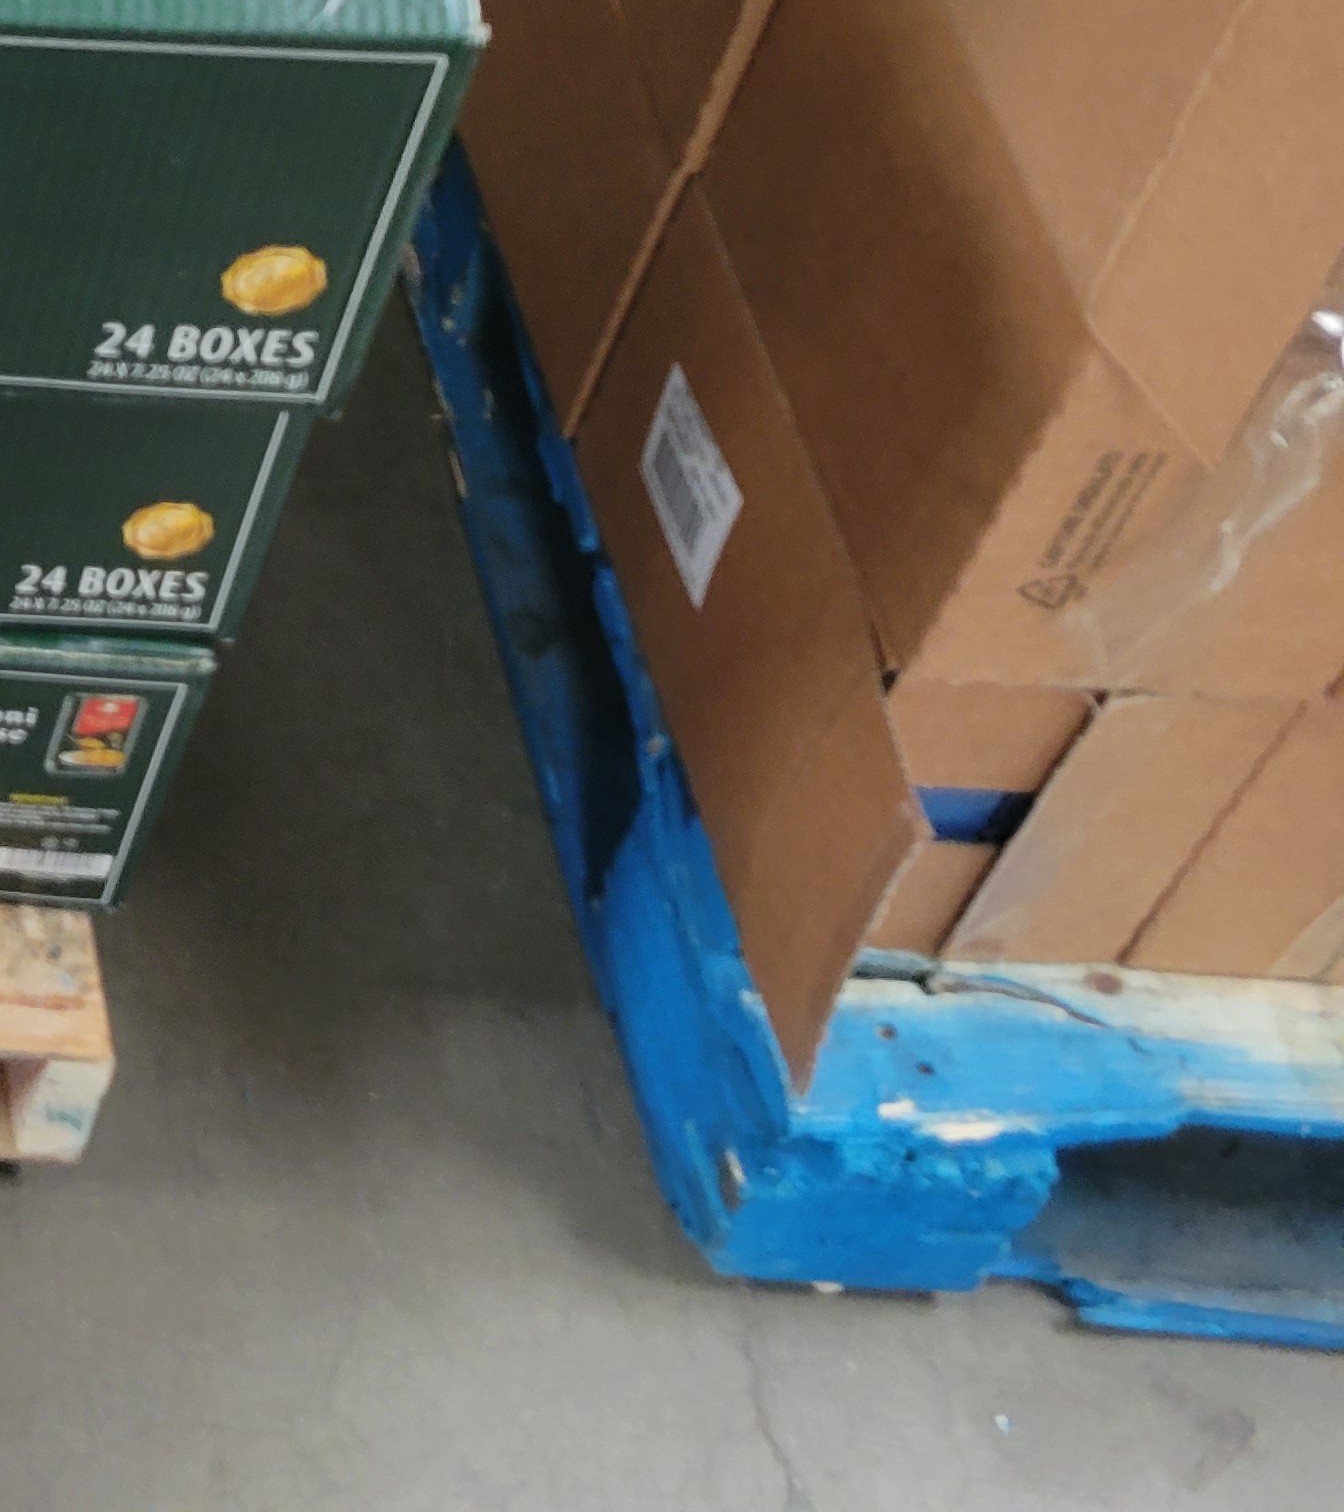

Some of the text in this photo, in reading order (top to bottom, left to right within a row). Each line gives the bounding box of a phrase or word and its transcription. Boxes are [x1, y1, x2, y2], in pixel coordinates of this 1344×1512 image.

[93, 320, 321, 367] 24 BOXES
[14, 563, 209, 602] 24 BOXES
